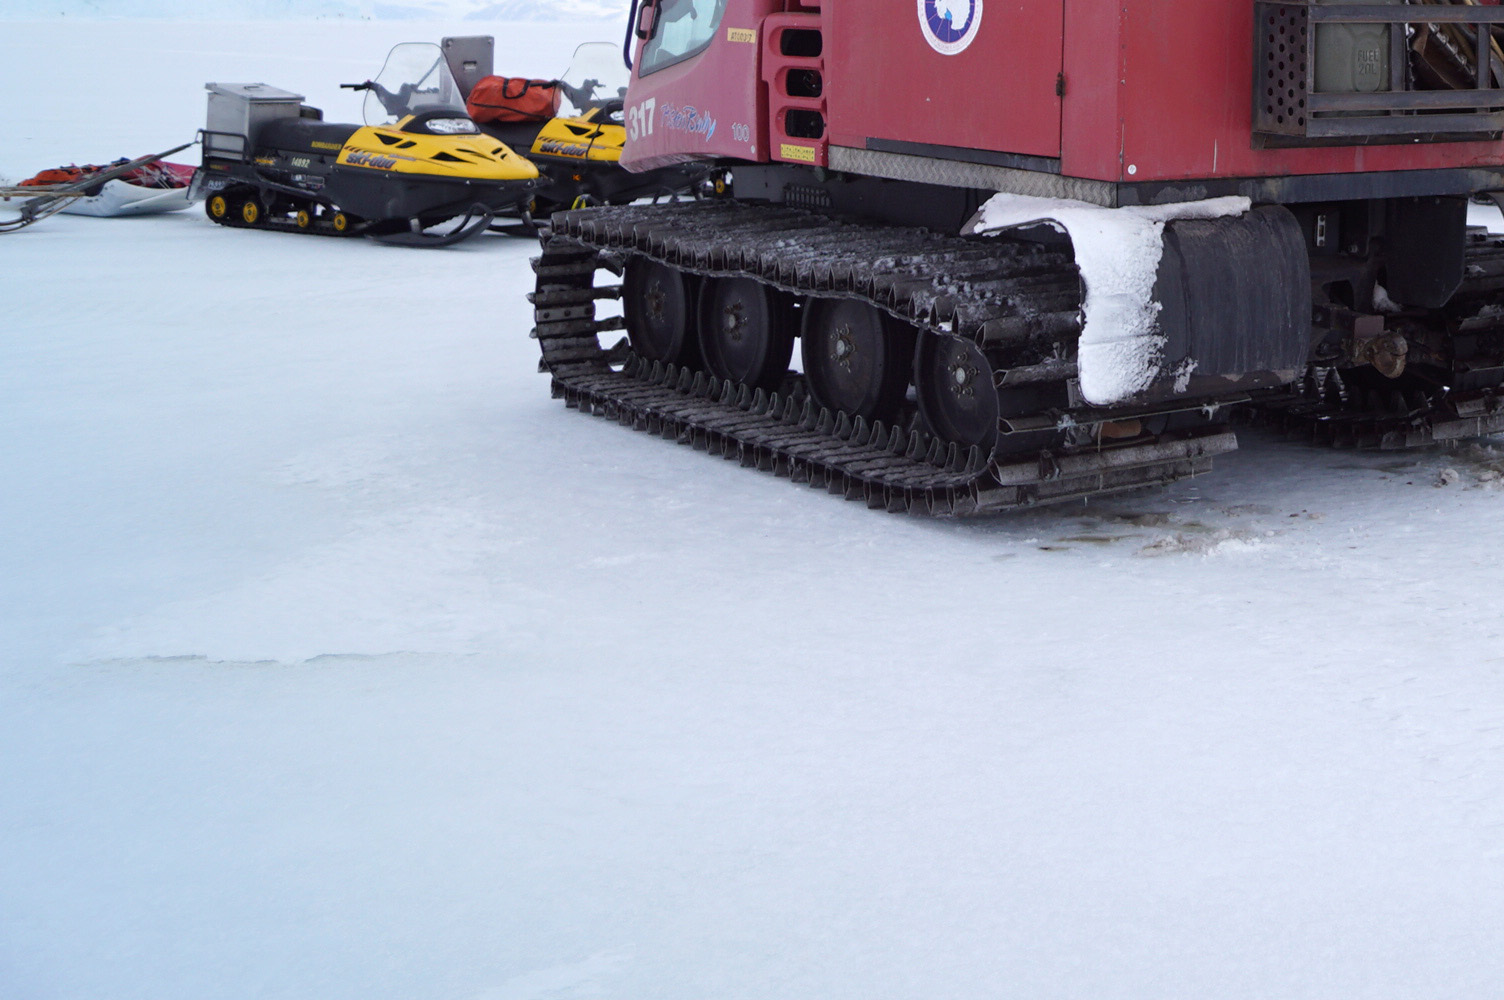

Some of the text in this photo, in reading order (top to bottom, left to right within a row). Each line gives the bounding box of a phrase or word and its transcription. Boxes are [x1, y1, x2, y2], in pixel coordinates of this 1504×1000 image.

[1357, 49, 1379, 62] FUEL
[628, 97, 656, 142] 317
[731, 122, 750, 142] 100
